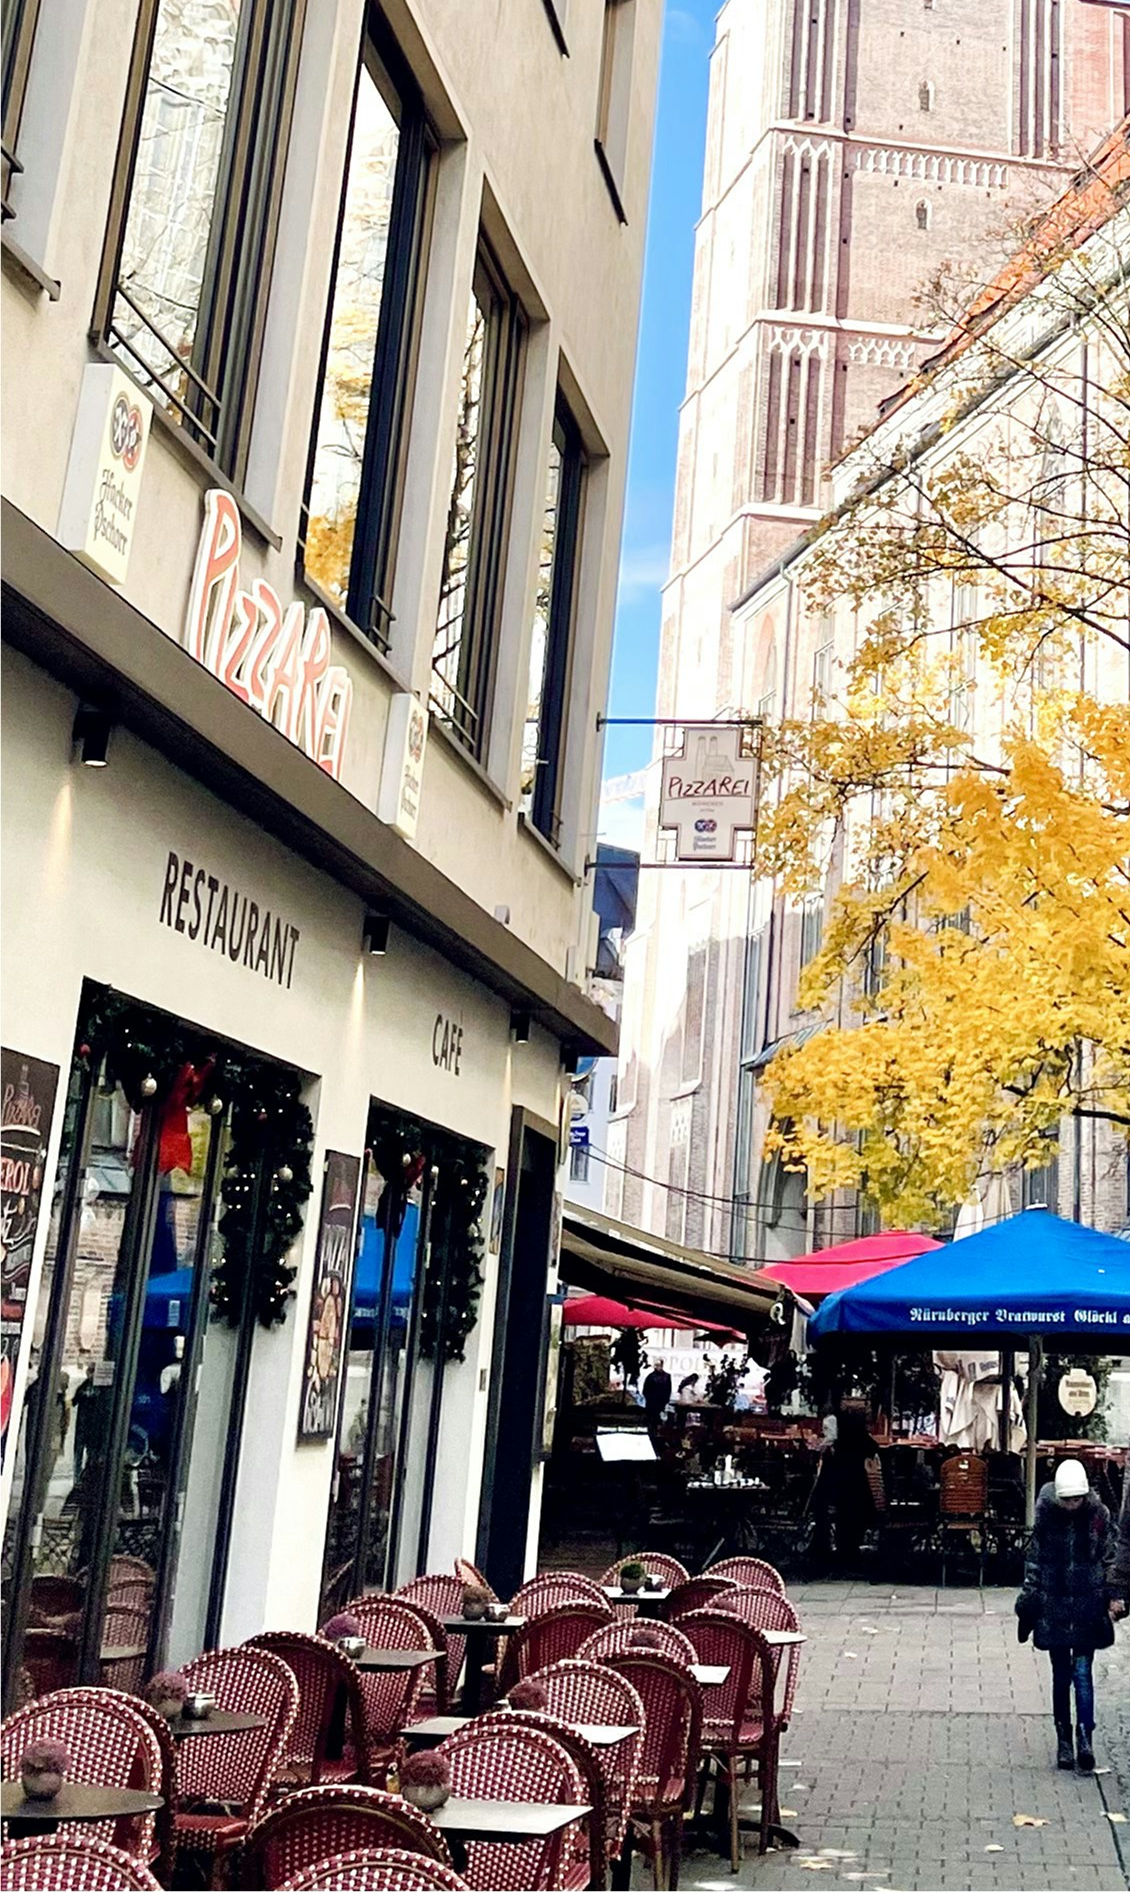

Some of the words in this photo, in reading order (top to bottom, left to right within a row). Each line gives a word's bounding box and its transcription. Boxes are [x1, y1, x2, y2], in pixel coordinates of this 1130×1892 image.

[668, 775, 750, 798] PIZZAREI
[158, 851, 300, 989] RESTAURANT
[910, 1308, 990, 1325] Nürnberger
[995, 1309, 1065, 1323] Bratwurst
[1073, 1309, 1118, 1324] Glöckl
